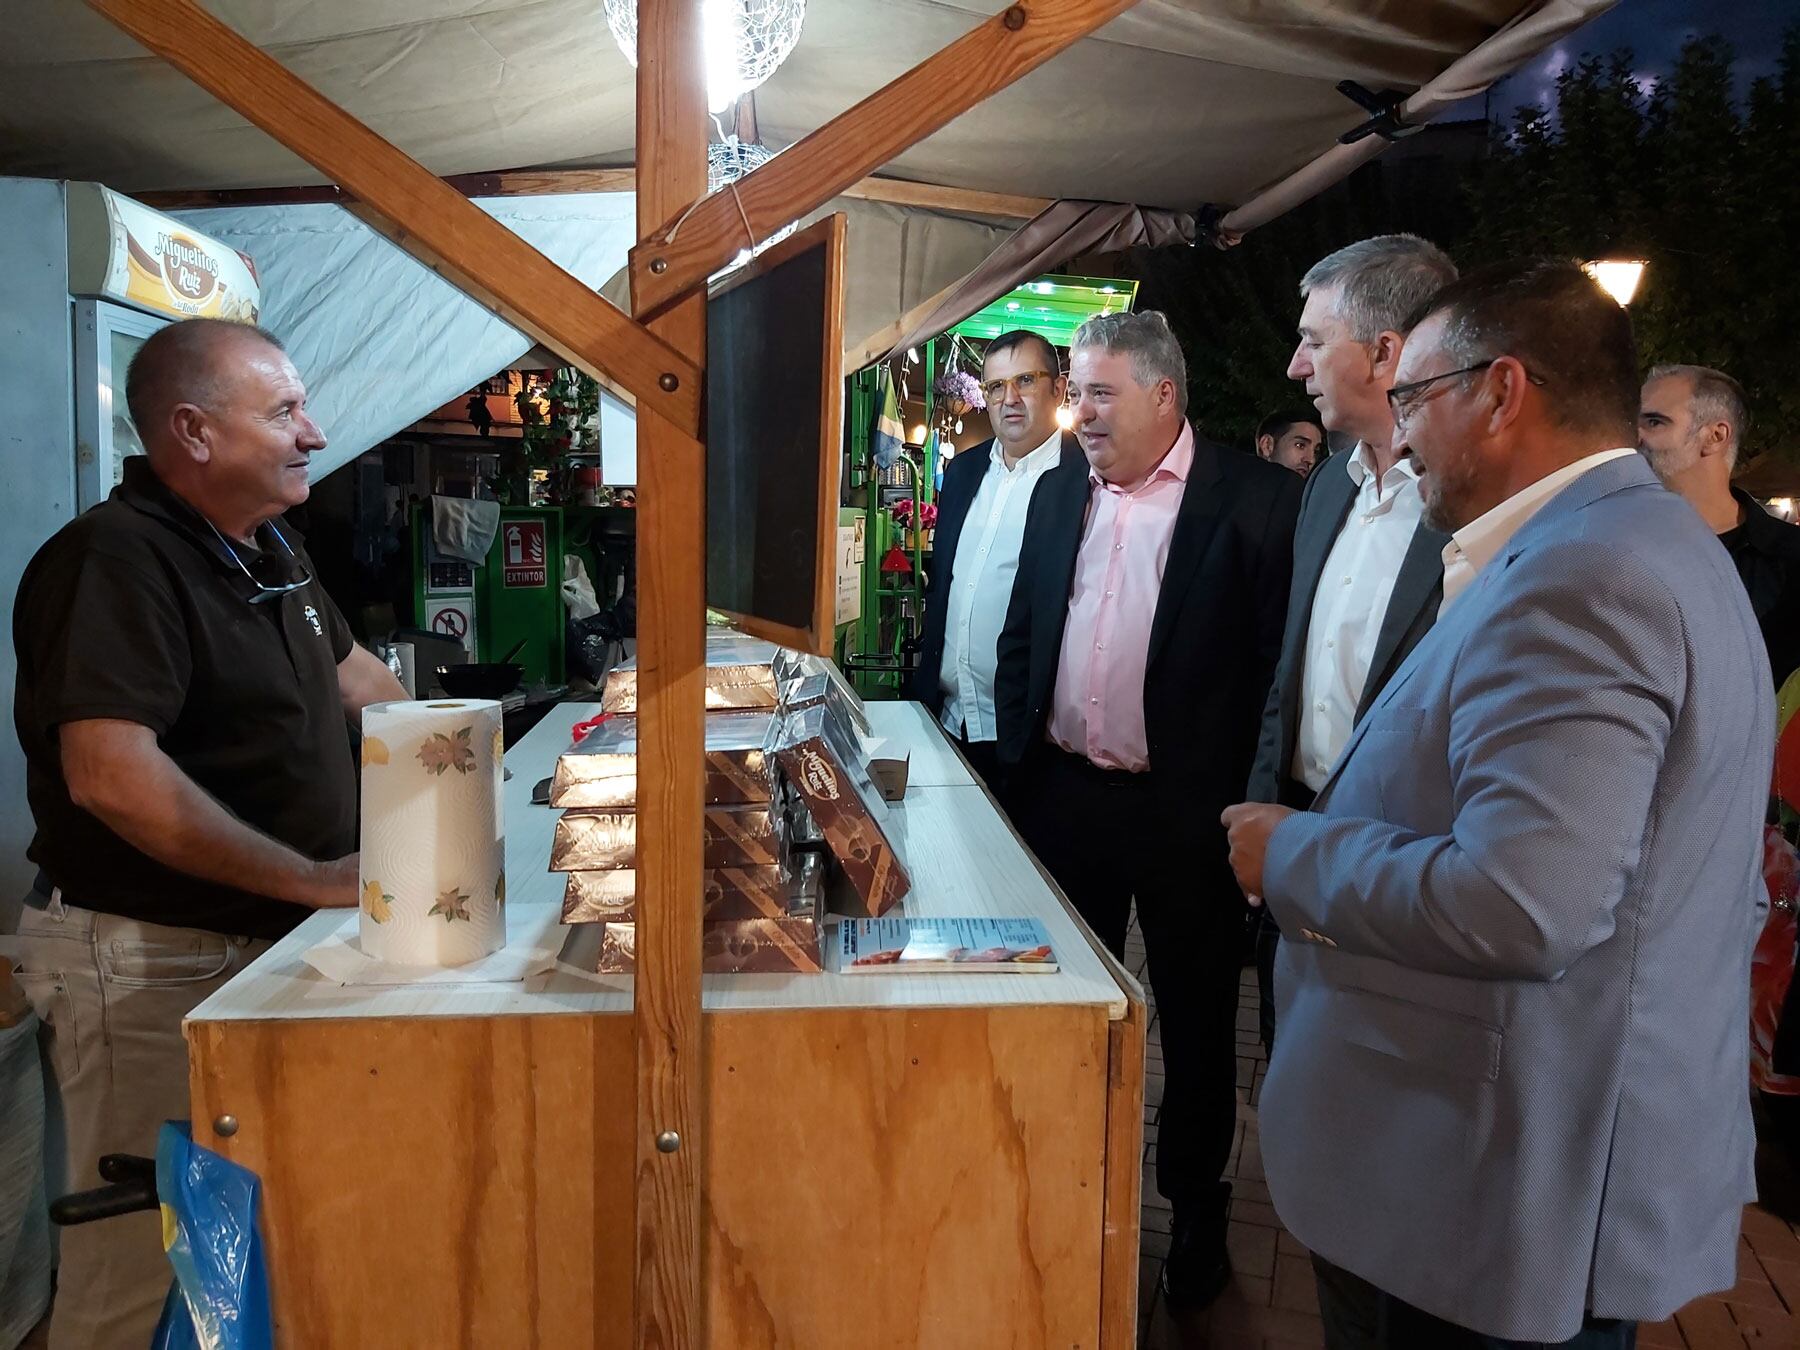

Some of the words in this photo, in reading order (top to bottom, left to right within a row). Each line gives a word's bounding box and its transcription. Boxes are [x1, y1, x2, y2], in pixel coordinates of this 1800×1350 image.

[155, 232, 219, 277] Miguelitos
[178, 266, 201, 296] Ruiz
[506, 572, 544, 582] EXTINTOR
[802, 749, 839, 800] Miguelitos
